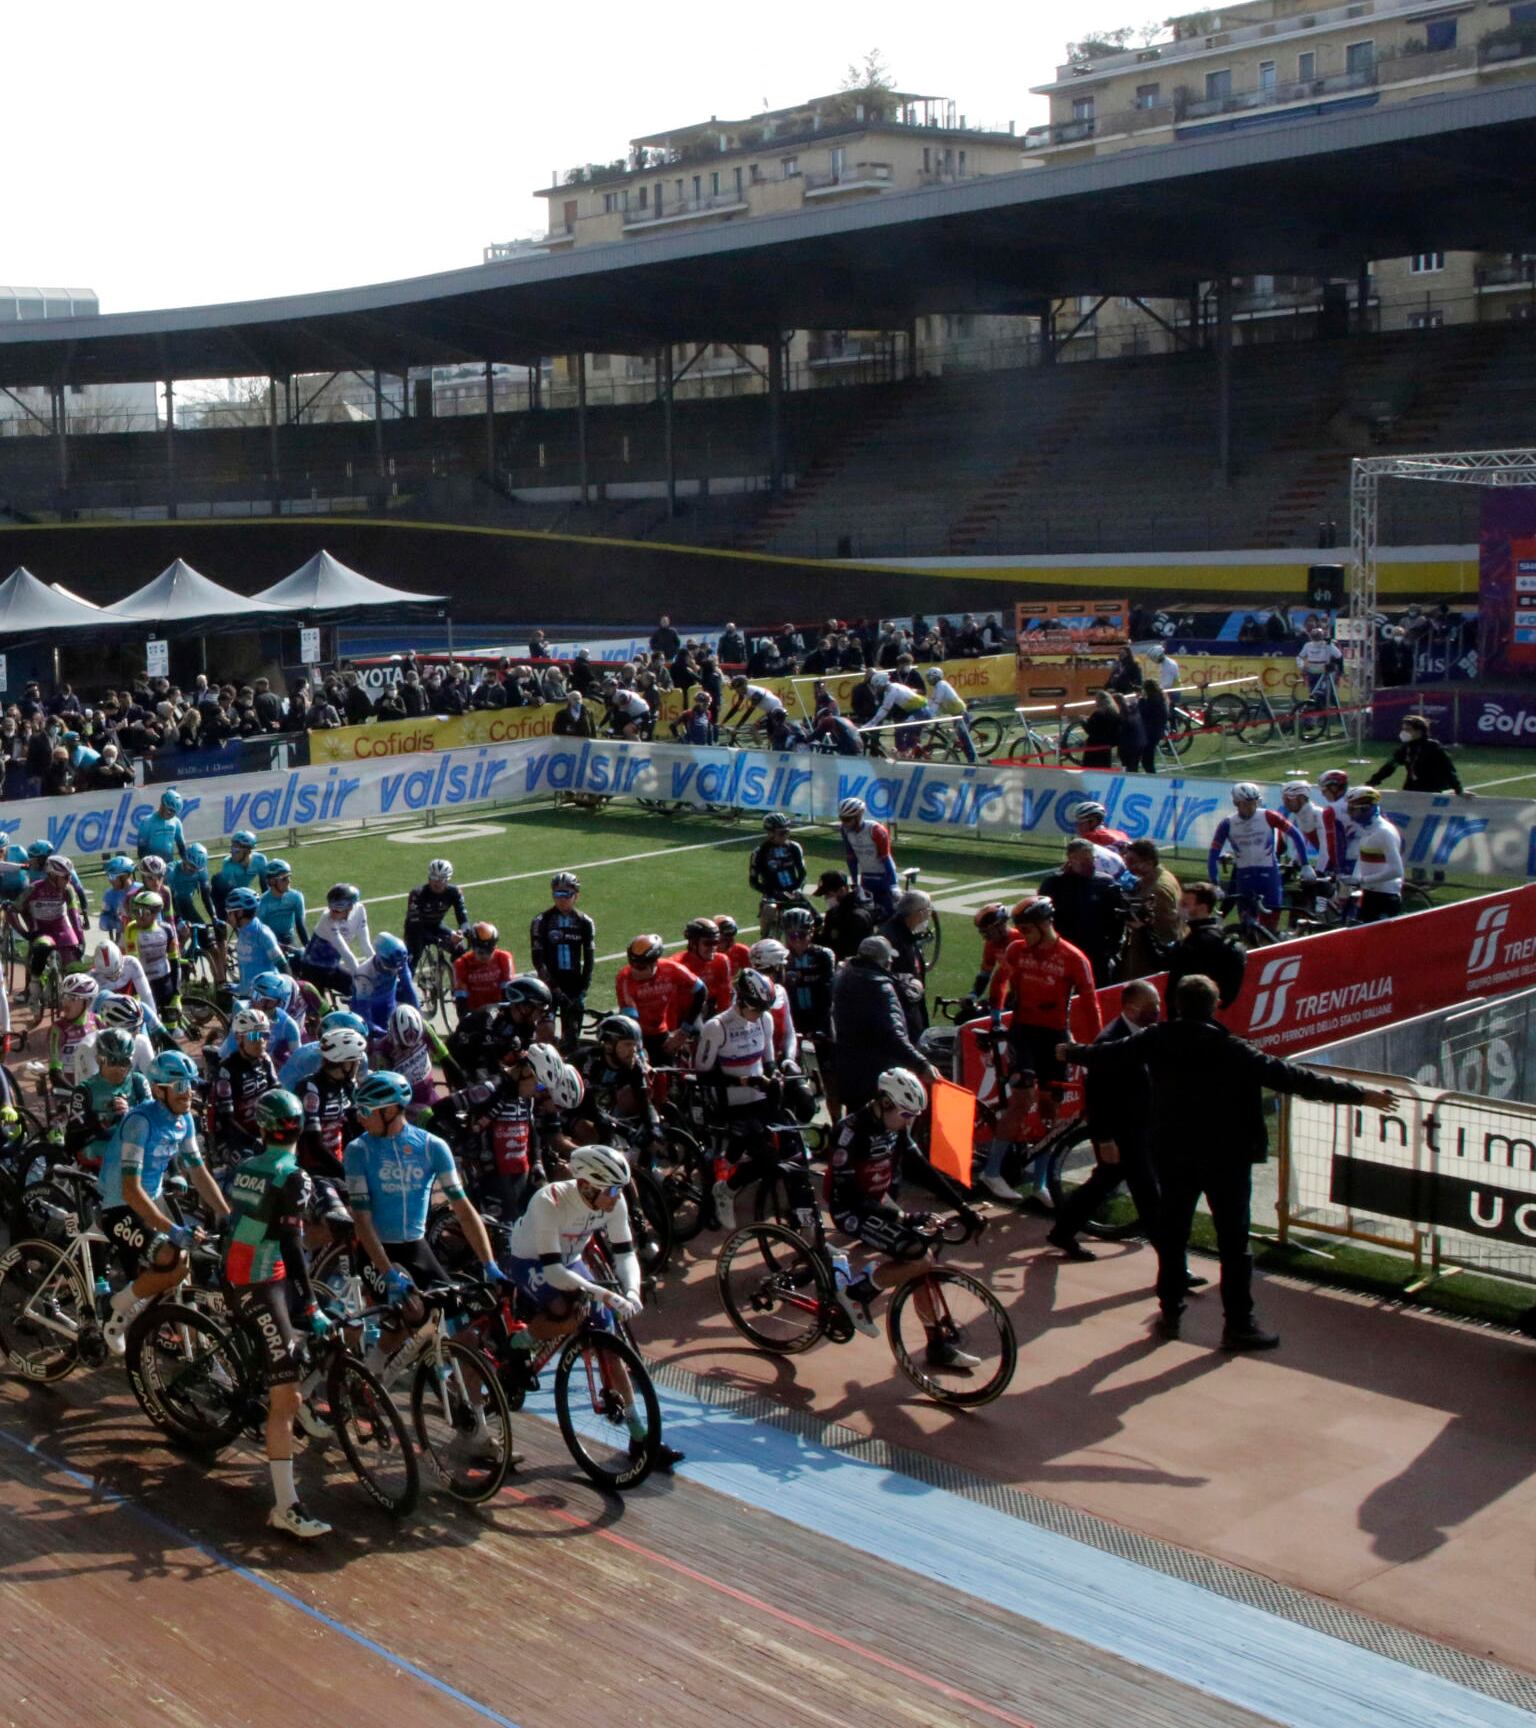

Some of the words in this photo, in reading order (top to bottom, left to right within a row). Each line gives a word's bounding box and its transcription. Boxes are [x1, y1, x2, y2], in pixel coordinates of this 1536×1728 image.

[353, 731, 435, 759] Cofidis
[489, 715, 553, 742] Cofidi
[380, 750, 507, 812] valsir
[525, 739, 651, 792] valsir
[671, 748, 812, 811] valsir
[223, 767, 360, 834] valsir
[837, 766, 1004, 826] valsir
[1020, 776, 1218, 841] valsir
[47, 791, 200, 855] valsr
[1296, 975, 1393, 1020] TRENITALIA
[1282, 1024, 1316, 1042] FERROVIE
[1316, 1018, 1339, 1033] DELLO
[1340, 1012, 1361, 1026] STATO
[379, 1164, 424, 1182] eolo
[65, 1215, 77, 1234] 105
[114, 1222, 144, 1248] eolo
[257, 1313, 287, 1362] BORA
